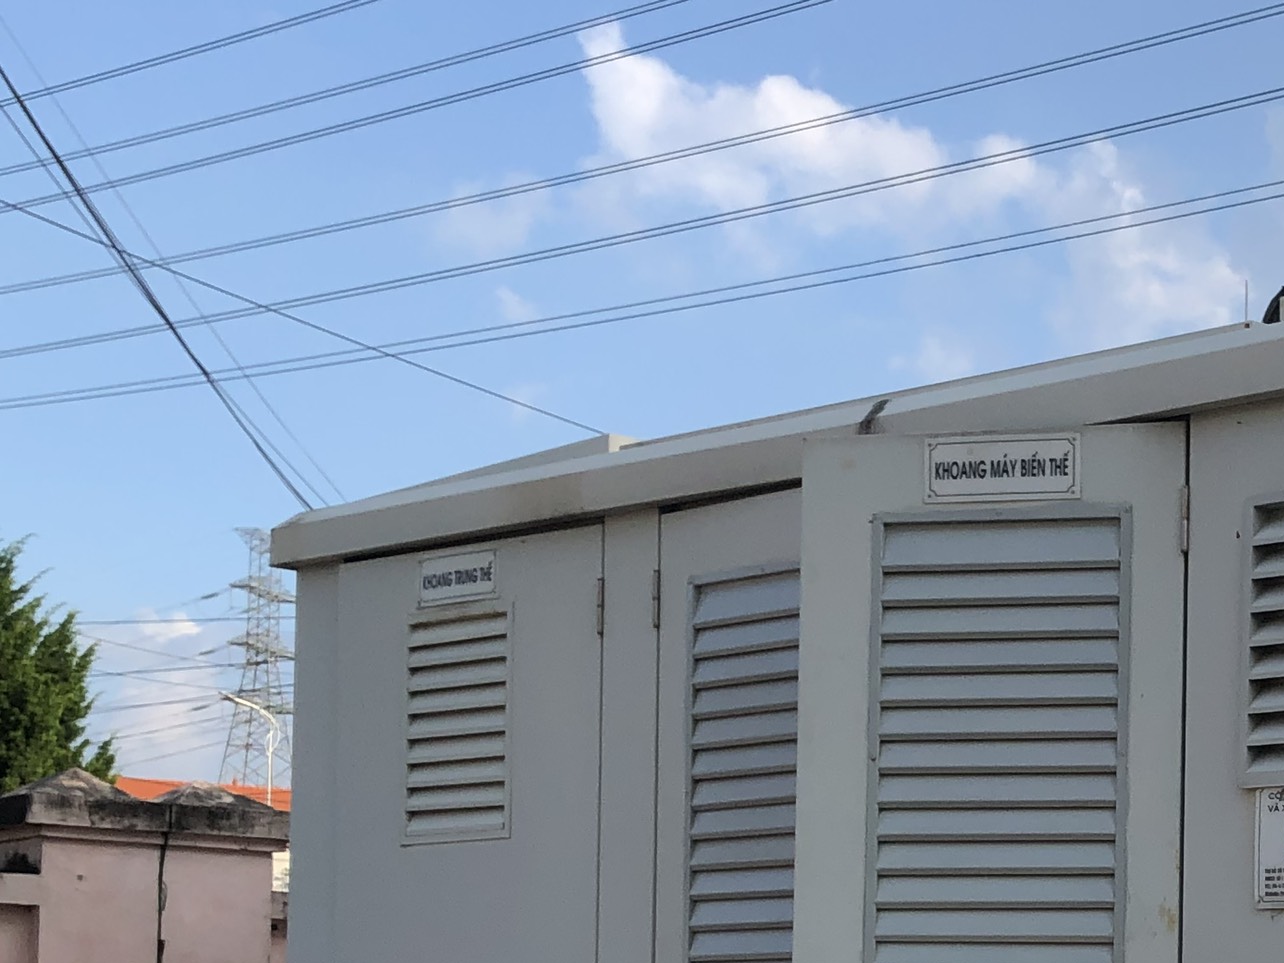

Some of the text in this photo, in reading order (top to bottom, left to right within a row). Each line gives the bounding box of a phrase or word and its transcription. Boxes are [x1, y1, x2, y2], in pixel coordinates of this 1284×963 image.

[934, 450, 1070, 480] KHOANG MÁY BIẾN THẾ
[423, 561, 492, 590] KHOANG TRUNG THẾ
